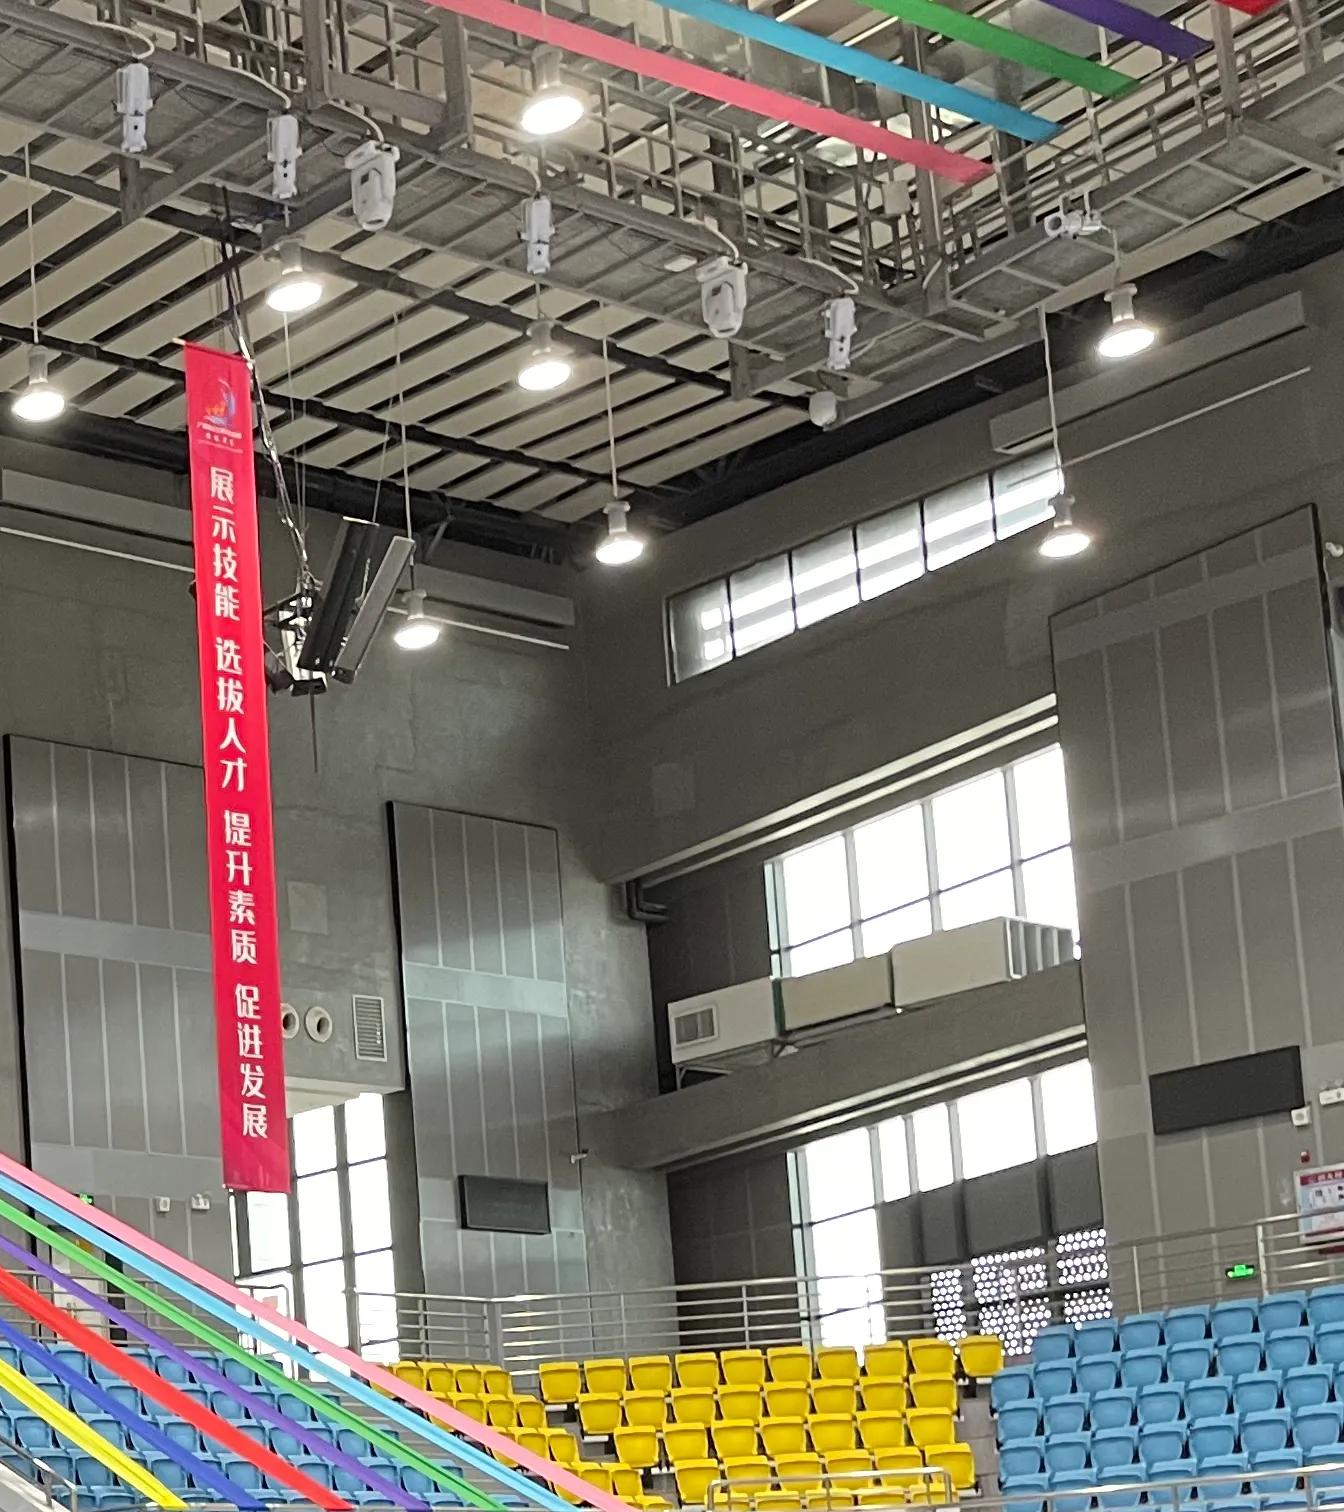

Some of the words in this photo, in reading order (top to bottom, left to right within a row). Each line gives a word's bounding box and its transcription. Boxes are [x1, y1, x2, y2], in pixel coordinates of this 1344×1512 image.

[209, 465, 241, 622] 展示技能
[215, 636, 248, 793] 选拔人才
[223, 809, 258, 965] 提升素质
[234, 982, 269, 1140] 促进发展
